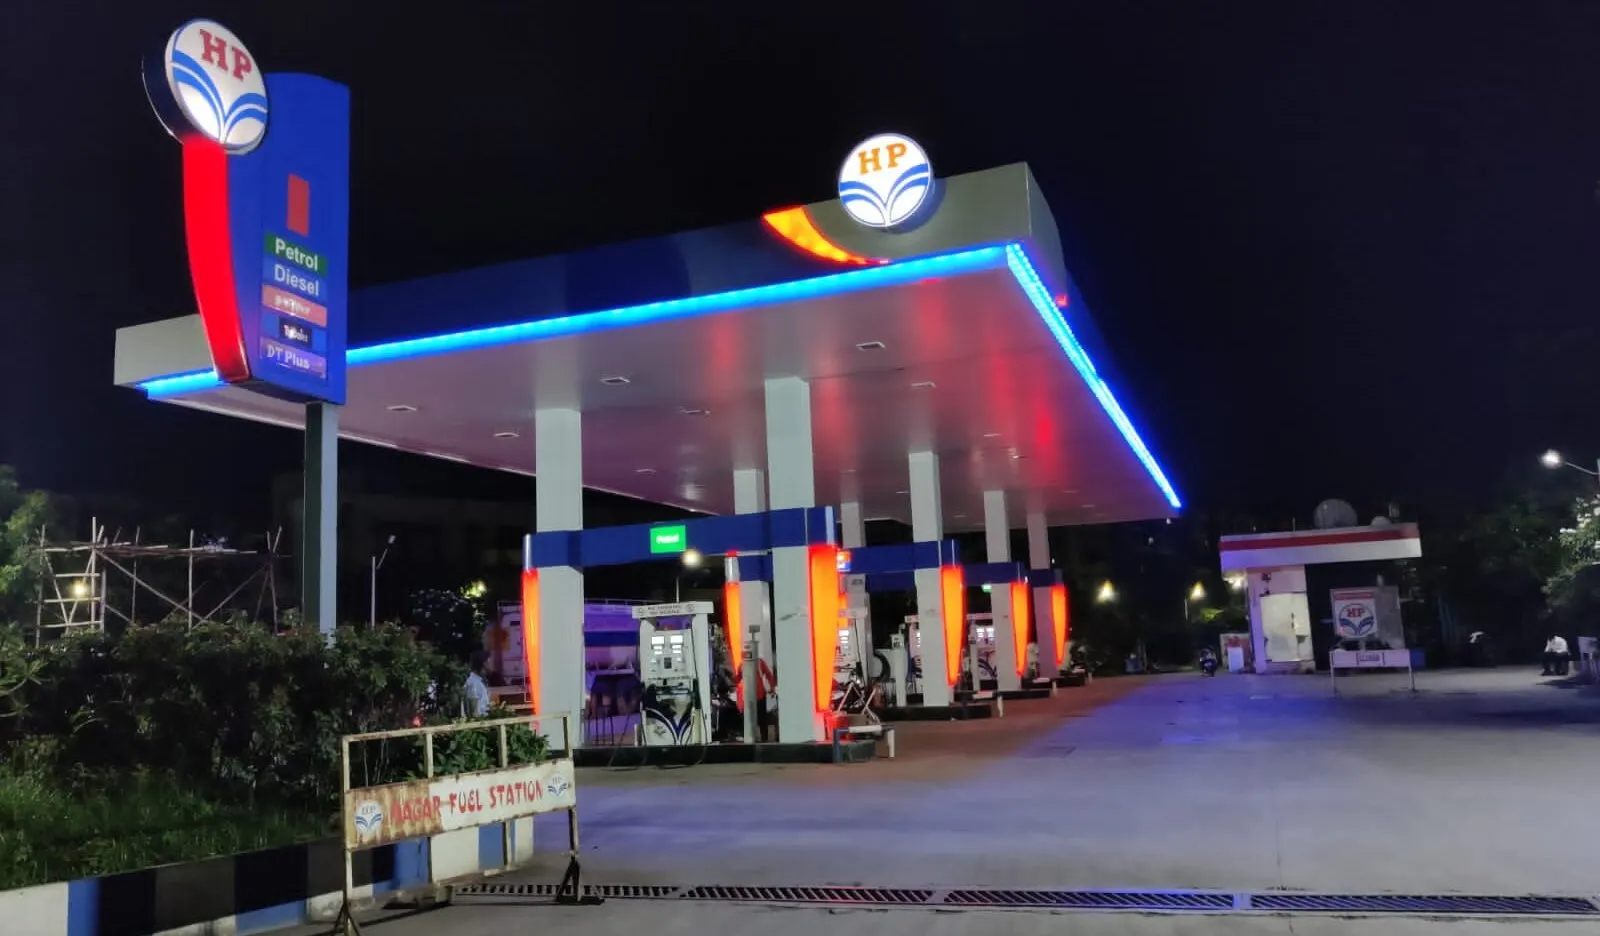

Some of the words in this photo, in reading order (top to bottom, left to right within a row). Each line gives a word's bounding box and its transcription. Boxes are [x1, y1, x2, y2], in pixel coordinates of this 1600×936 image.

[199, 28, 252, 81] HP
[858, 143, 906, 174] HP
[275, 238, 318, 271] Petrol
[274, 264, 319, 296] Diesel
[267, 344, 283, 362] DT
[284, 347, 310, 368] Plus
[448, 787, 484, 816] FUEL
[489, 780, 544, 809] STATION
